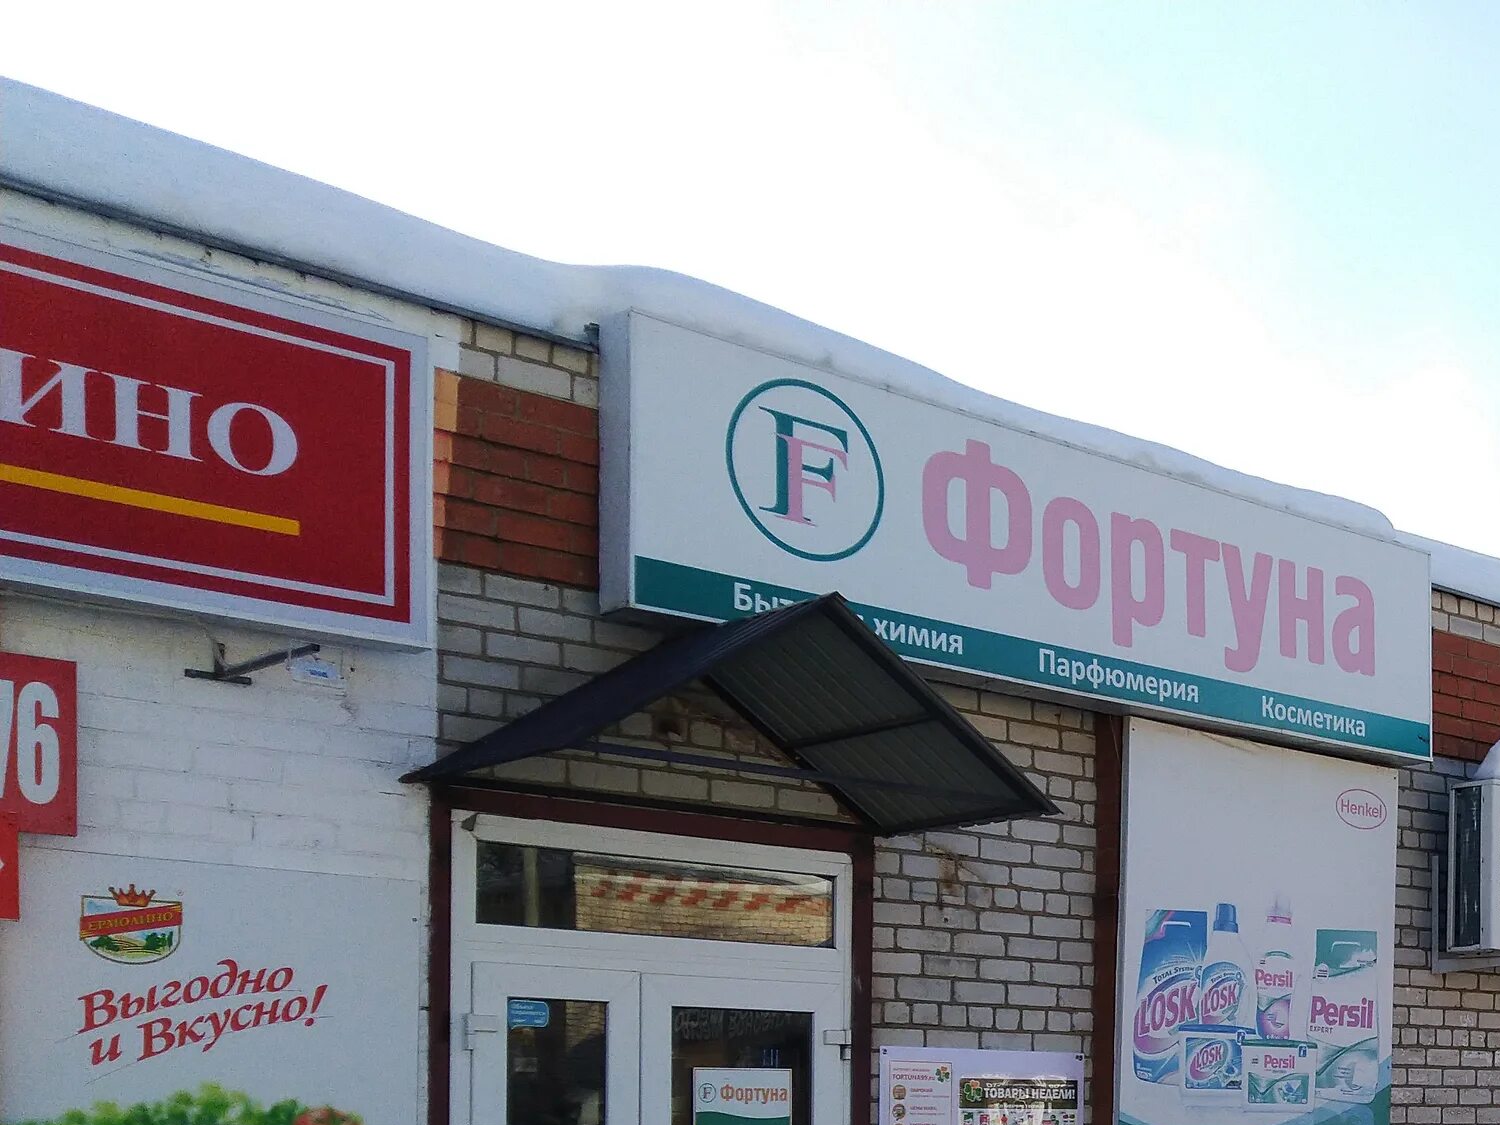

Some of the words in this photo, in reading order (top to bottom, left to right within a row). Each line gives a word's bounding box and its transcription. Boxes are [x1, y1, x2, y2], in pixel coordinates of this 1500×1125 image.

[921, 438, 1376, 676] Фортуна
[874, 617, 963, 655] химия
[1039, 648, 1199, 703] Парфюмерия
[1262, 696, 1366, 737] Косметика
[1340, 799, 1383, 819] Henkel
[87, 911, 174, 931] ЕРМОЛИНО
[1255, 969, 1293, 988] Persil
[78, 959, 294, 1034] Выгодно
[1139, 979, 1198, 1036] LOSK
[1203, 983, 1238, 1016] LOSK
[1310, 996, 1374, 1029] Persil
[89, 1034, 122, 1065] и
[137, 984, 328, 1062] Вкусно!
[1309, 1025, 1334, 1034] EXPERT
[1264, 1055, 1295, 1069] Persil
[720, 1083, 788, 1104] Фортуна
[984, 1087, 1029, 1099] ТОВАРЫ
[1032, 1088, 1076, 1101] НЕДЕЛИ!
